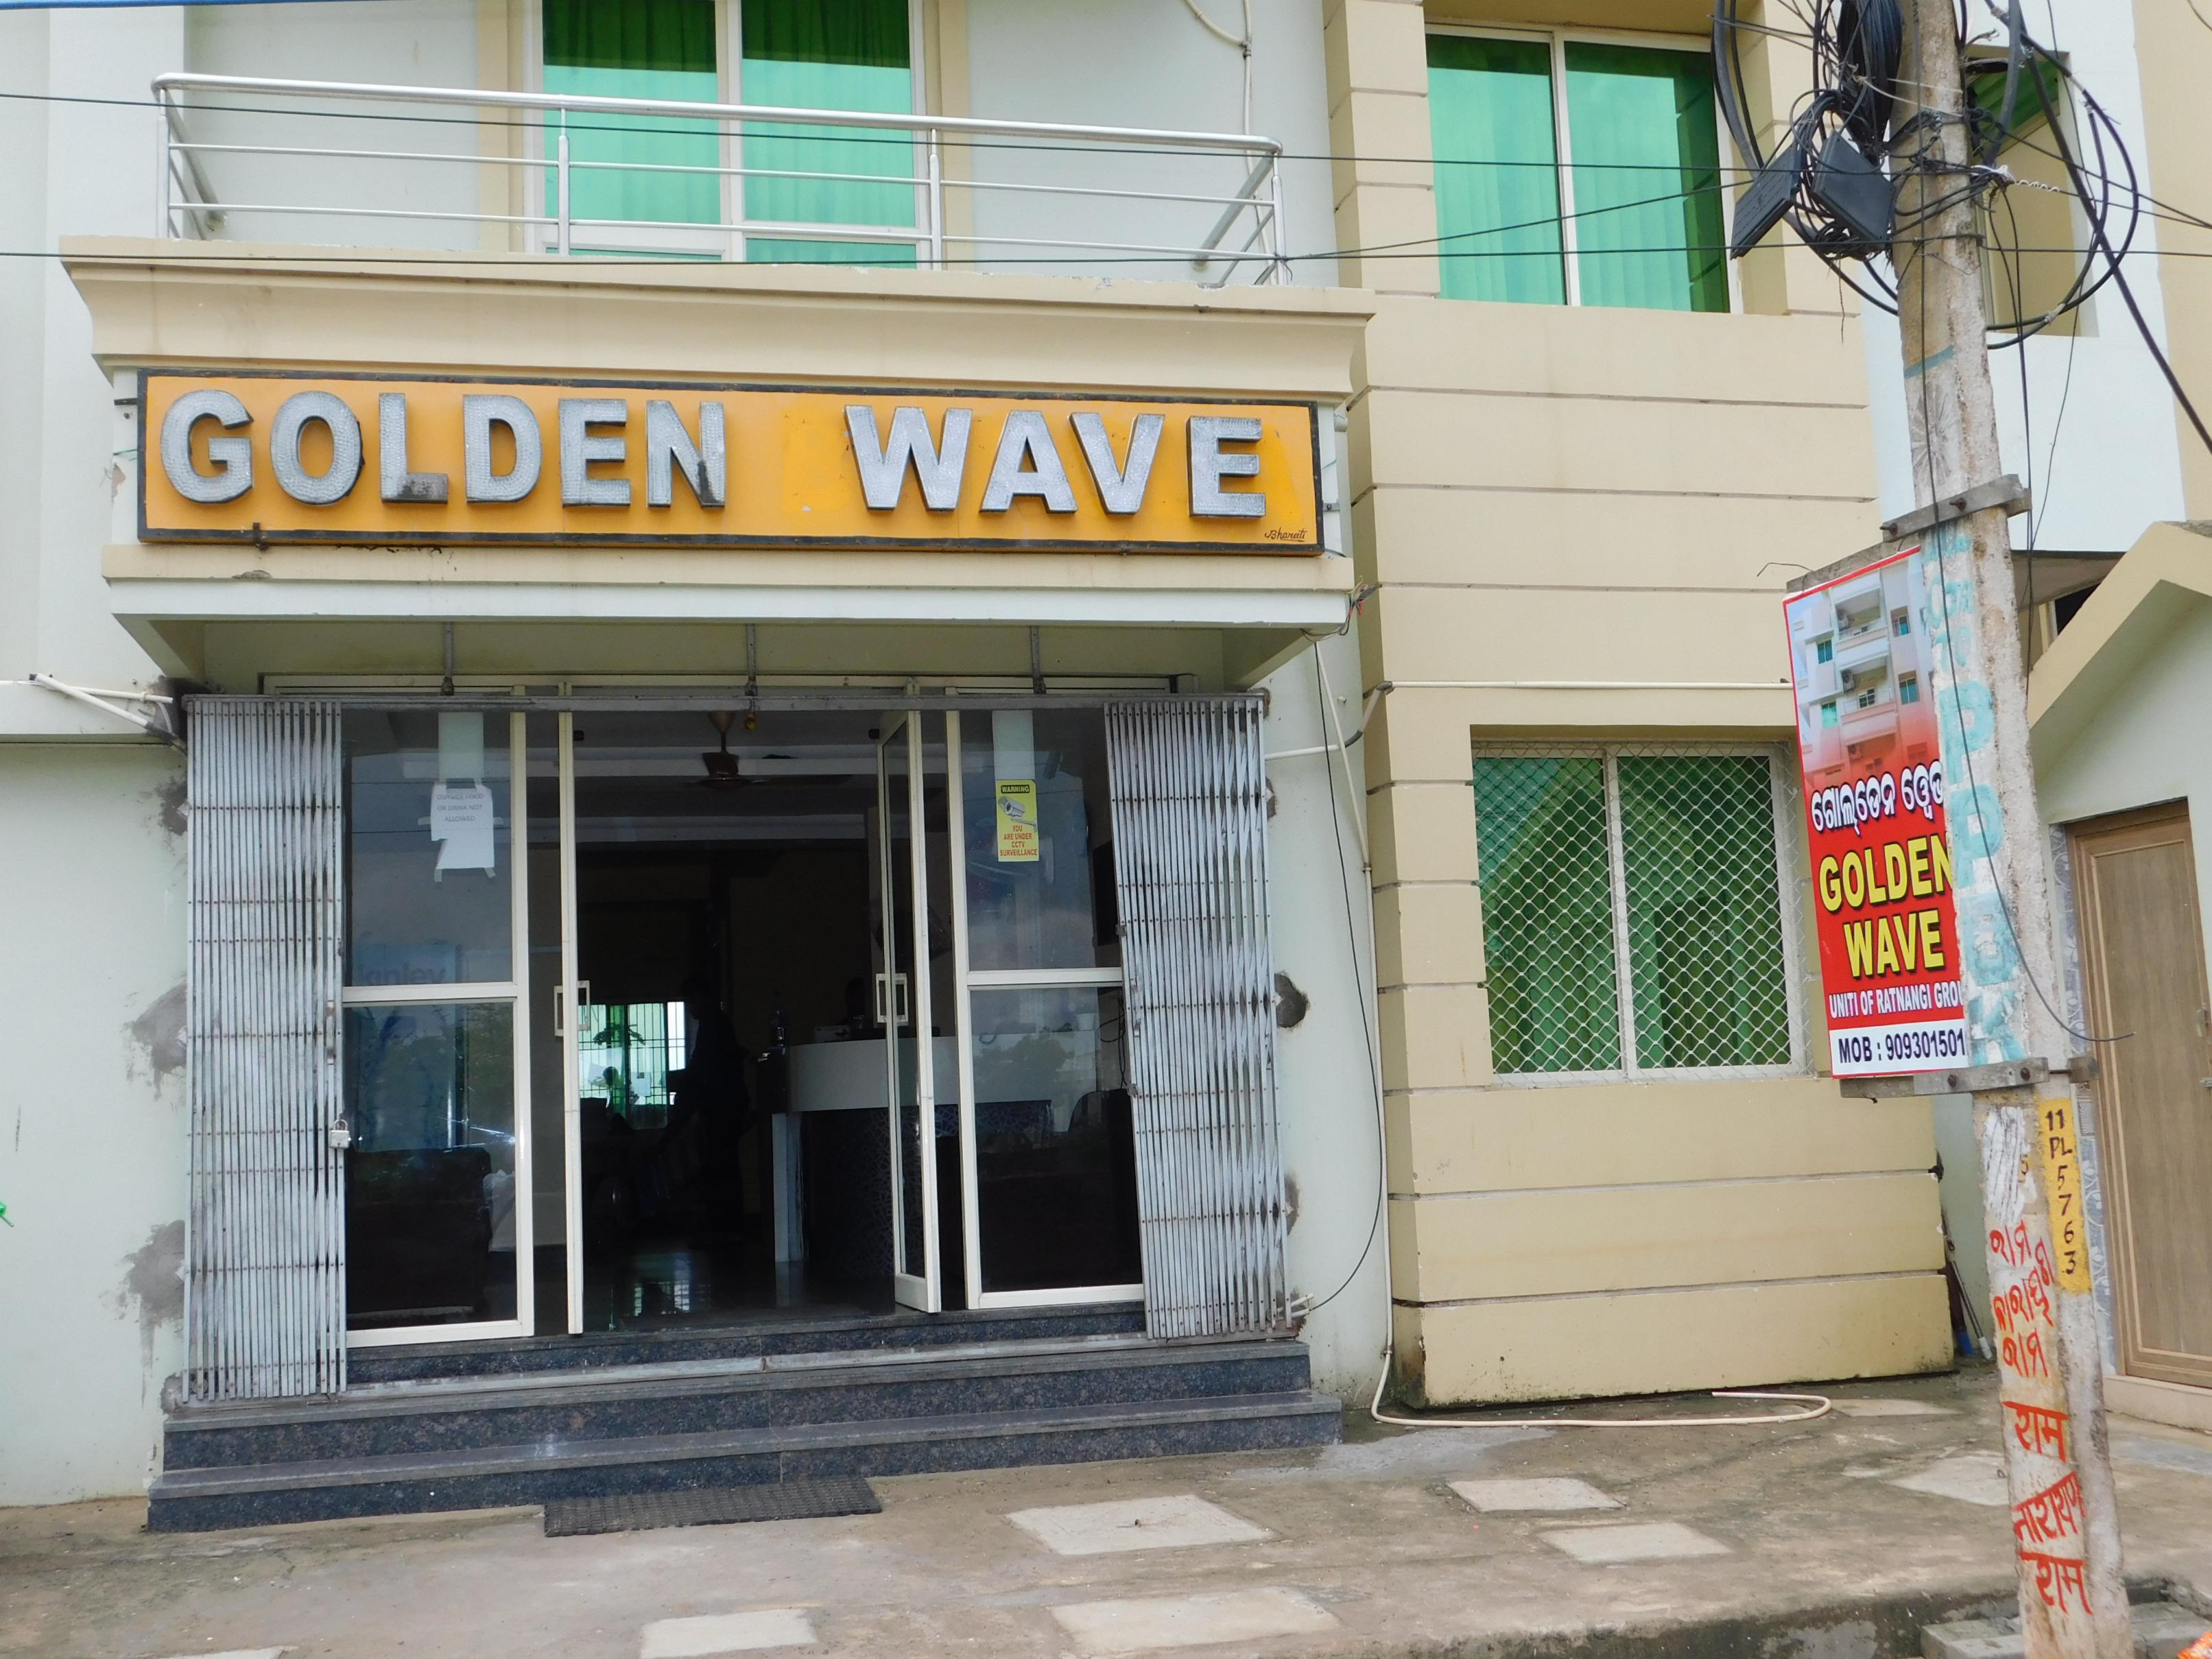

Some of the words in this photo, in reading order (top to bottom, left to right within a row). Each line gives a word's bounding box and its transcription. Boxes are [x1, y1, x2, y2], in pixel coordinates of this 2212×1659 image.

[160, 389, 726, 508] GOLDEN
[844, 404, 1266, 518] WAVE
[1000, 848, 1038, 857] SURVEILLANCE
[1819, 835, 1953, 912] GOLDEN
[1843, 909, 1945, 977] WAVE
[1829, 992, 1859, 1018] UNITI
[1860, 990, 1874, 1016] OF
[1876, 983, 1932, 1014] RATNANGI
[1838, 1036, 1872, 1063] MOB
[1885, 1027, 1966, 1061] 909301501
[2001, 1400, 2070, 1464] राम
[2019, 1550, 2094, 1616] राम
